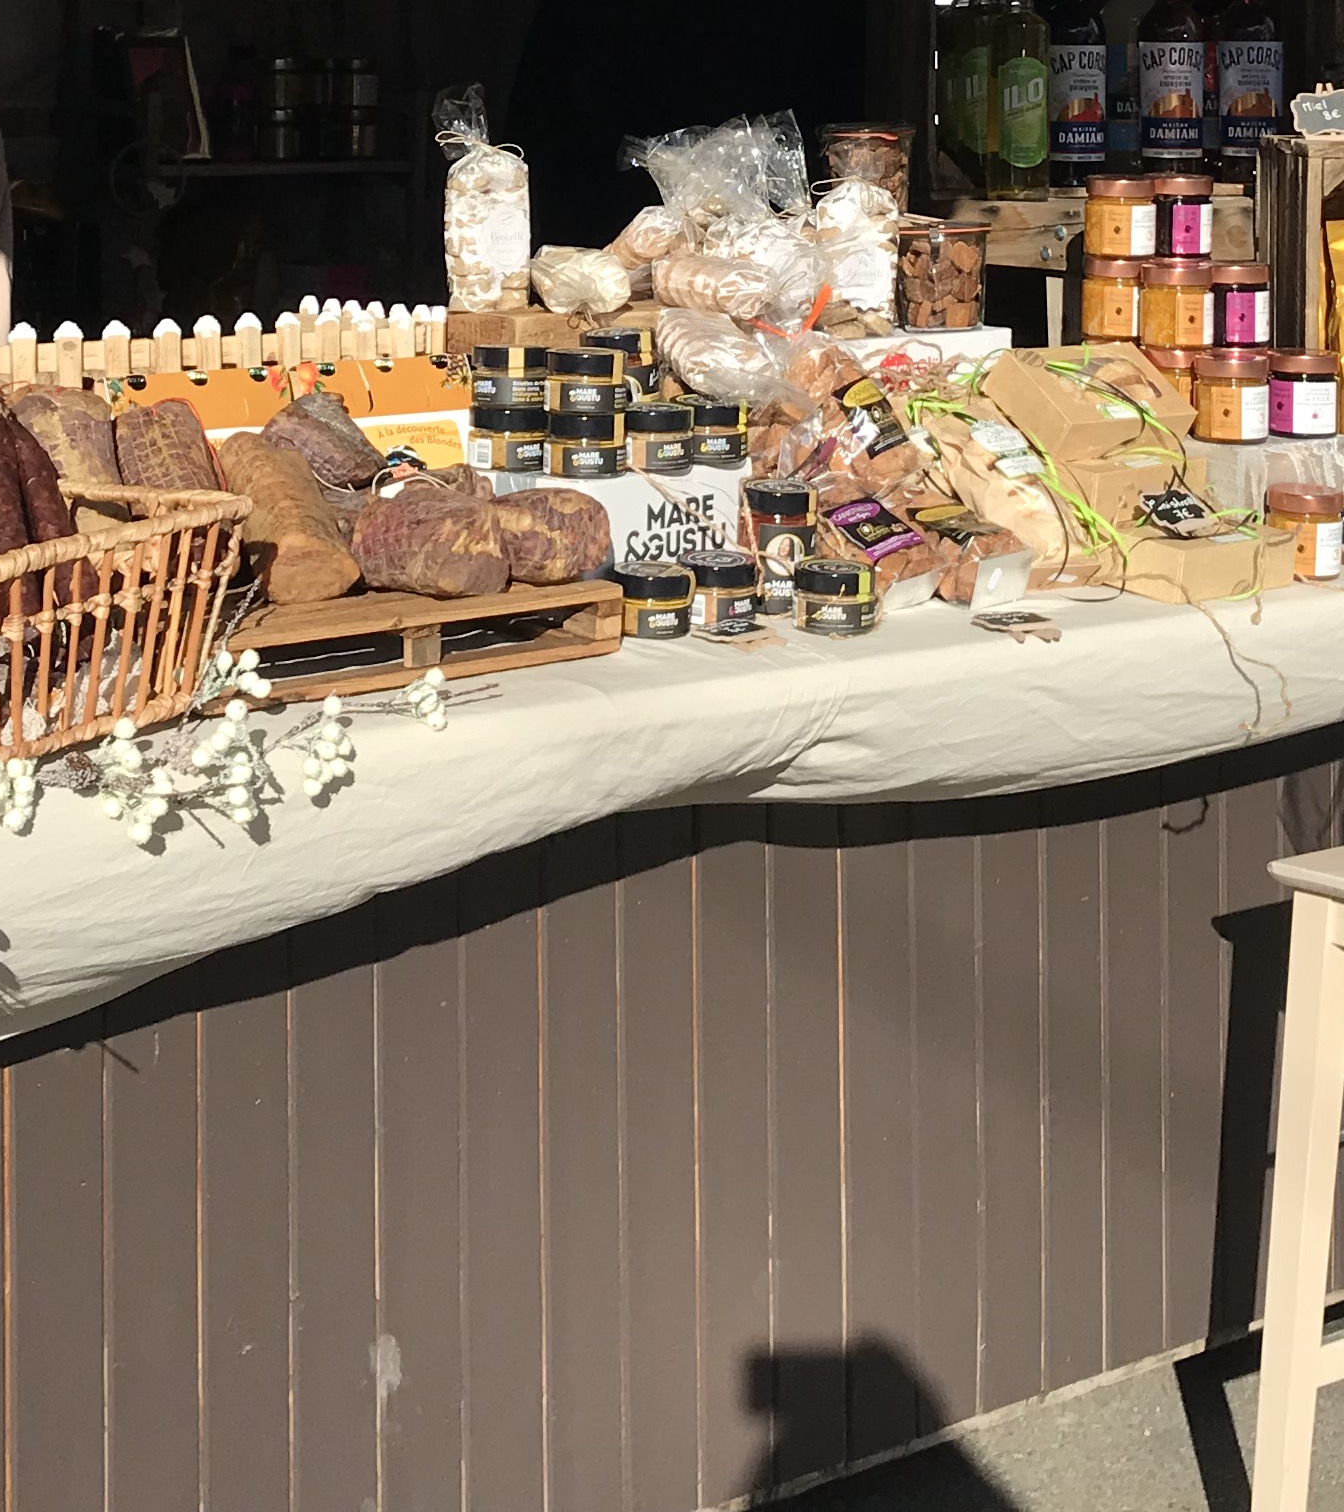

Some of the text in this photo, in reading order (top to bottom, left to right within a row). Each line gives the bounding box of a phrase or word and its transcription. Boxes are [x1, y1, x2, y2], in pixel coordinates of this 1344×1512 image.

[1050, 50, 1106, 76] CAP CORS
[1142, 46, 1204, 72] CAP CORSE
[1221, 45, 1282, 72] CAP CORSE
[965, 74, 989, 100] IL
[1003, 77, 1044, 112] ILO
[1301, 99, 1328, 111] Miel
[1323, 109, 1342, 121] 8€
[1149, 127, 1199, 140] DAMIANI
[576, 388, 598, 396] MARE
[385, 426, 394, 436] la
[395, 424, 446, 436] découverte
[409, 434, 463, 450] des Blondes
[646, 493, 715, 532] MARE
[771, 580, 794, 589] MAR
